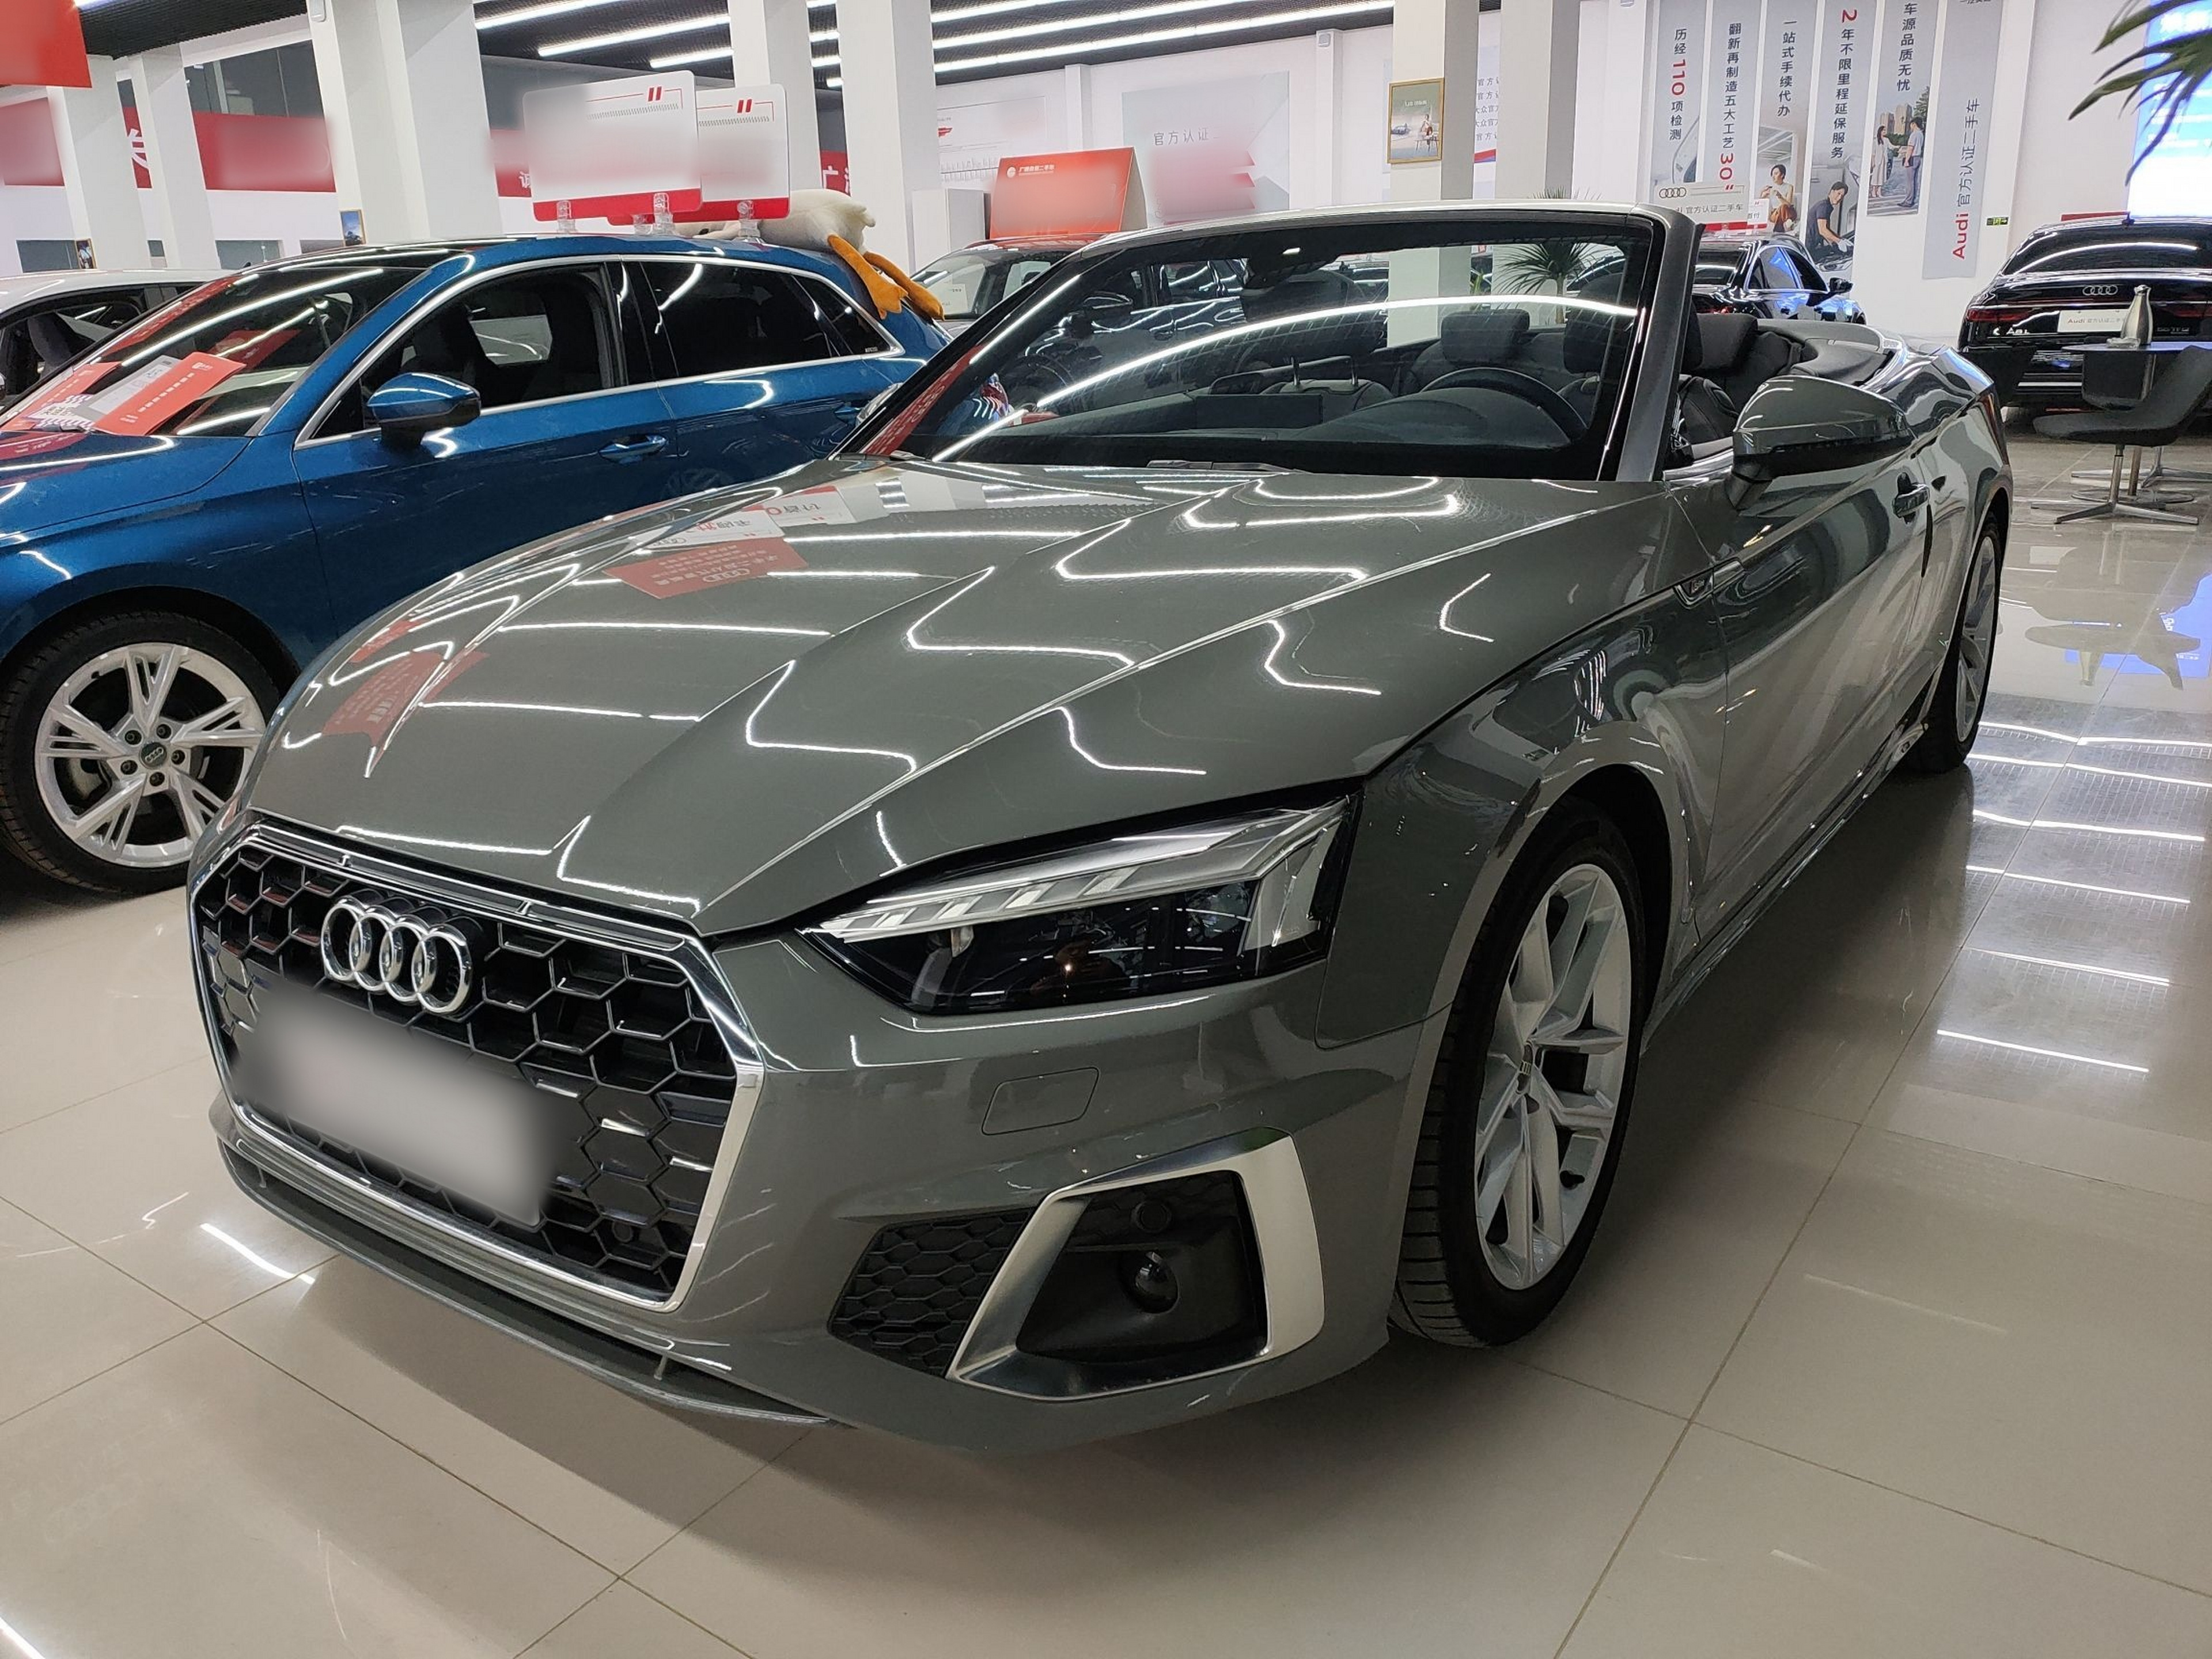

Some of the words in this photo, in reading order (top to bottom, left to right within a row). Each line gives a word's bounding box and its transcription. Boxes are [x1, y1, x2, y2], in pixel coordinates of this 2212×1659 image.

[1777, 20, 1797, 117] 一站式手续代办
[1896, 2, 1917, 92] 车源品质无忧
[1957, 98, 1980, 207] 官方认证二手车
[1685, 203, 1743, 214] 官方认证二手车
[1952, 213, 1969, 259] Audi
